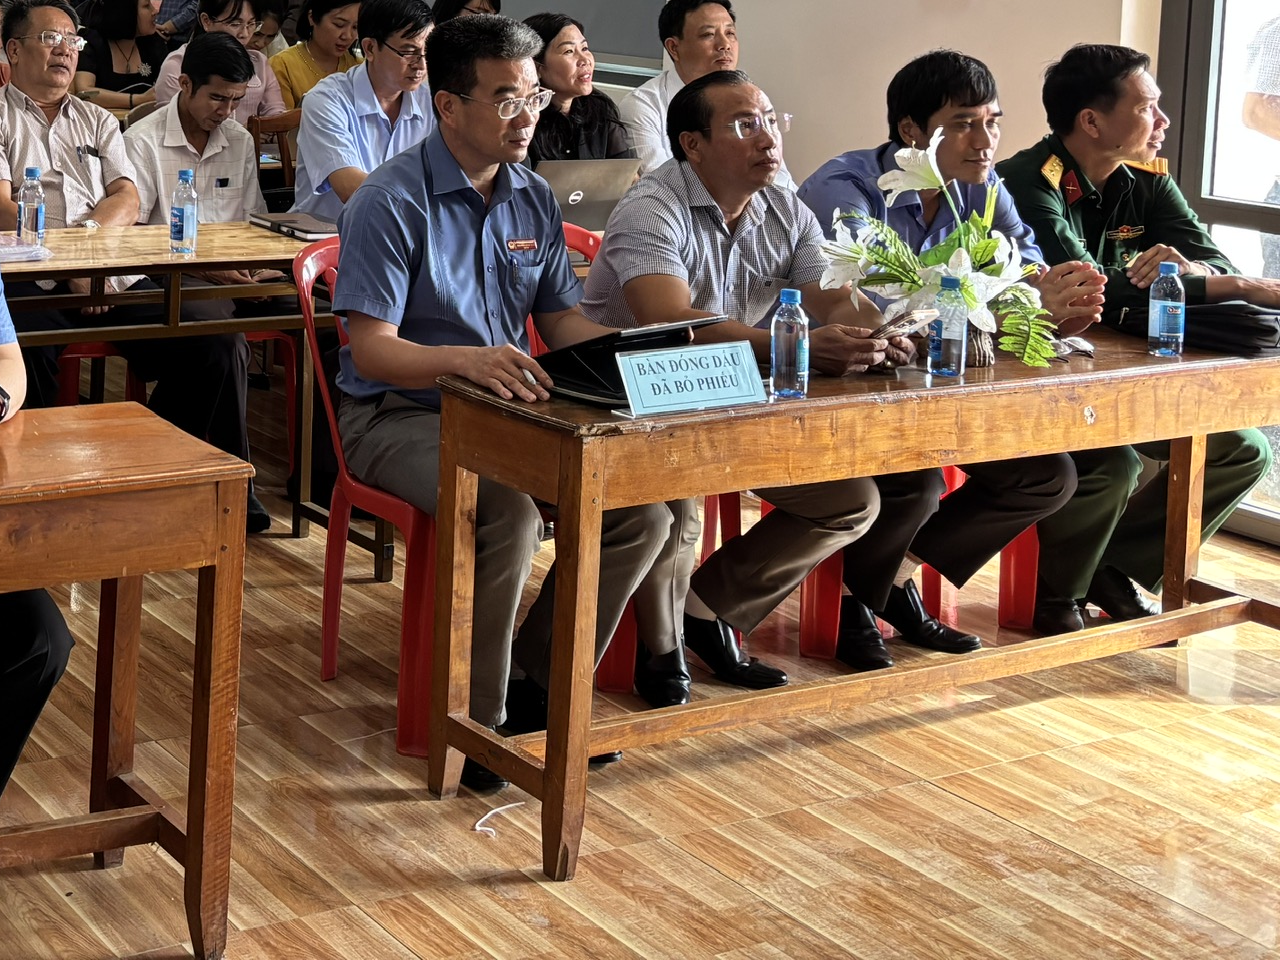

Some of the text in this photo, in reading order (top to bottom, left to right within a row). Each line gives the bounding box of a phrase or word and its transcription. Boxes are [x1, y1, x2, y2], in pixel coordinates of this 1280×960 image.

[636, 349, 741, 376] BÀN ĐÓNG DẤU
[650, 371, 740, 396] ĐÃ BỎ PHIẾU
